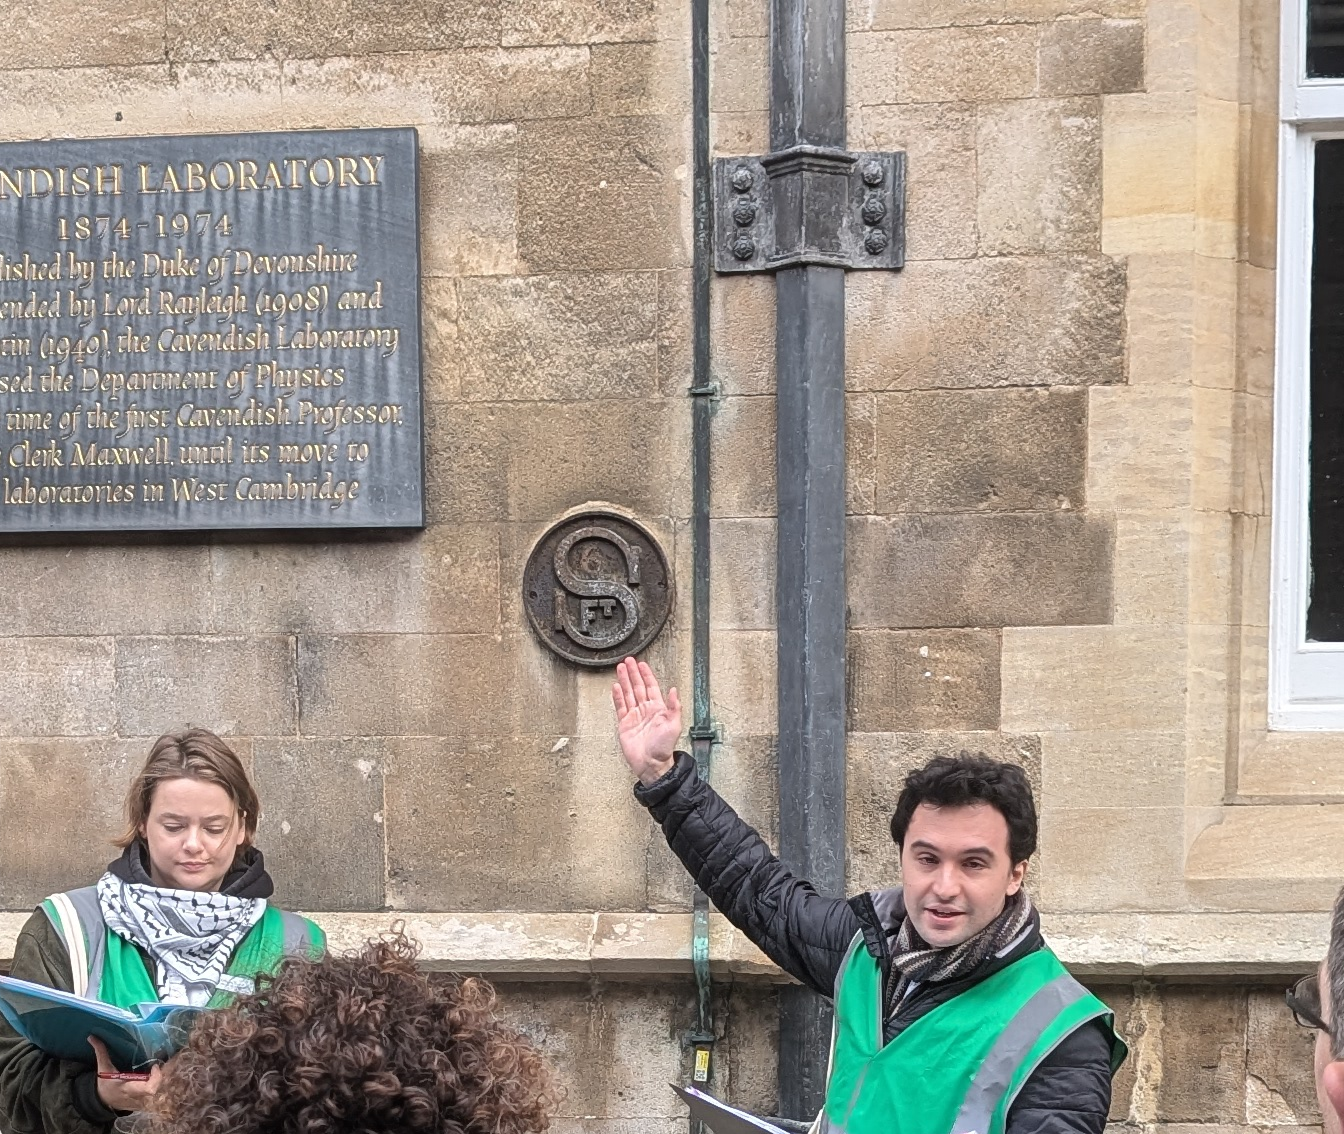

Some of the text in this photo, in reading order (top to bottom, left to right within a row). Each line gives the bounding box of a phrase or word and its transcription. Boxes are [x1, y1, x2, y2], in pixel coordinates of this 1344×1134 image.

[137, 154, 386, 194] LABORATORY
[67, 250, 95, 289] by
[103, 250, 136, 279] the
[142, 247, 200, 278] Duke
[207, 248, 232, 286] of
[233, 244, 359, 276] Devonshire
[69, 289, 96, 328] by
[102, 286, 152, 317] Lord
[158, 285, 249, 326] Rayleigh
[256, 285, 329, 321] (1908)
[338, 280, 384, 311] and
[117, 325, 151, 353] the
[157, 322, 271, 353] Cavendish
[277, 321, 400, 358] Laboratory
[40, 365, 75, 394] the
[80, 366, 218, 400] Department
[226, 362, 252, 400] of
[255, 359, 346, 398] Physics
[6, 407, 52, 431] time
[59, 404, 82, 441] of
[86, 401, 120, 429] the
[115, 402, 171, 439] first
[177, 397, 291, 428] Cavendish
[297, 396, 404, 435] Professor,
[8, 439, 64, 469] Clerk
[71, 436, 174, 469] Maxwell,
[179, 435, 234, 464] until
[241, 440, 270, 463] its
[278, 443, 338, 463] move
[347, 441, 369, 463] to
[2, 476, 135, 505] laboratories
[142, 479, 164, 502] in
[171, 477, 229, 502] West
[235, 471, 360, 509] Cambridge
